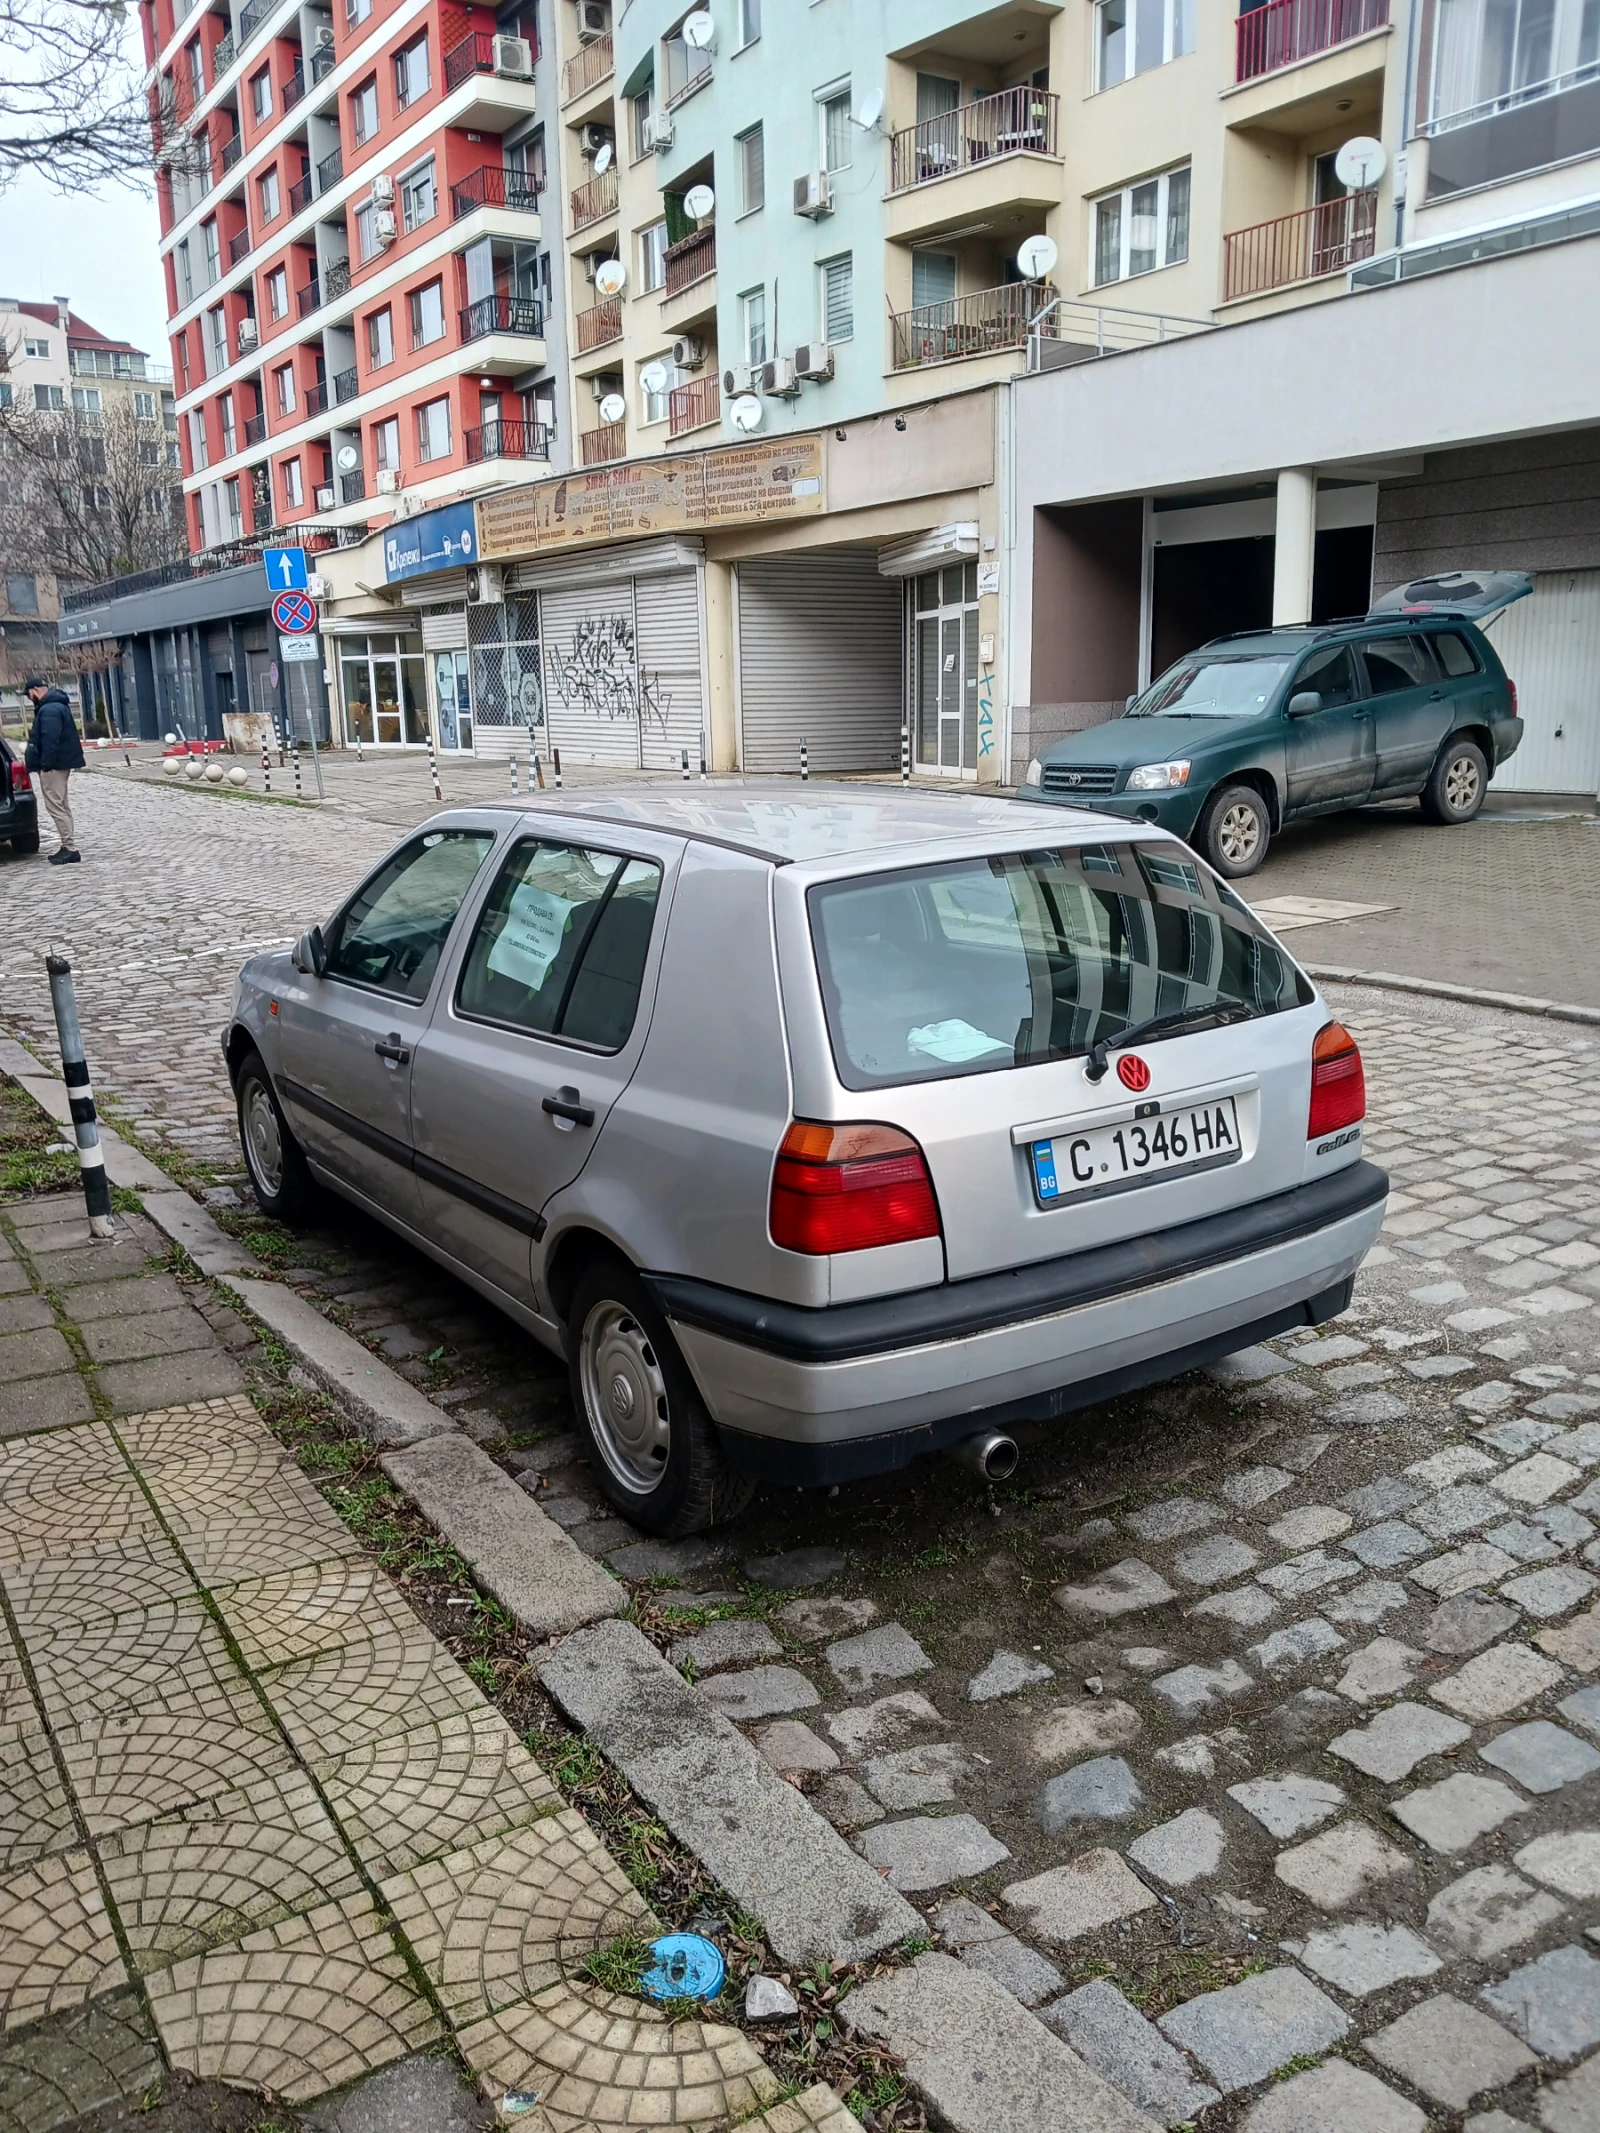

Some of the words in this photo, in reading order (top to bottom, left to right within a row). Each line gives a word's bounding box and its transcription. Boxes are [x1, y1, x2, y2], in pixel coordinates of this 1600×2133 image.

[612, 467, 631, 486] Soft
[693, 464, 757, 482] виеонаблюдение
[1112, 1116, 1188, 1172] 1346
[1040, 1175, 1056, 1191] BG
